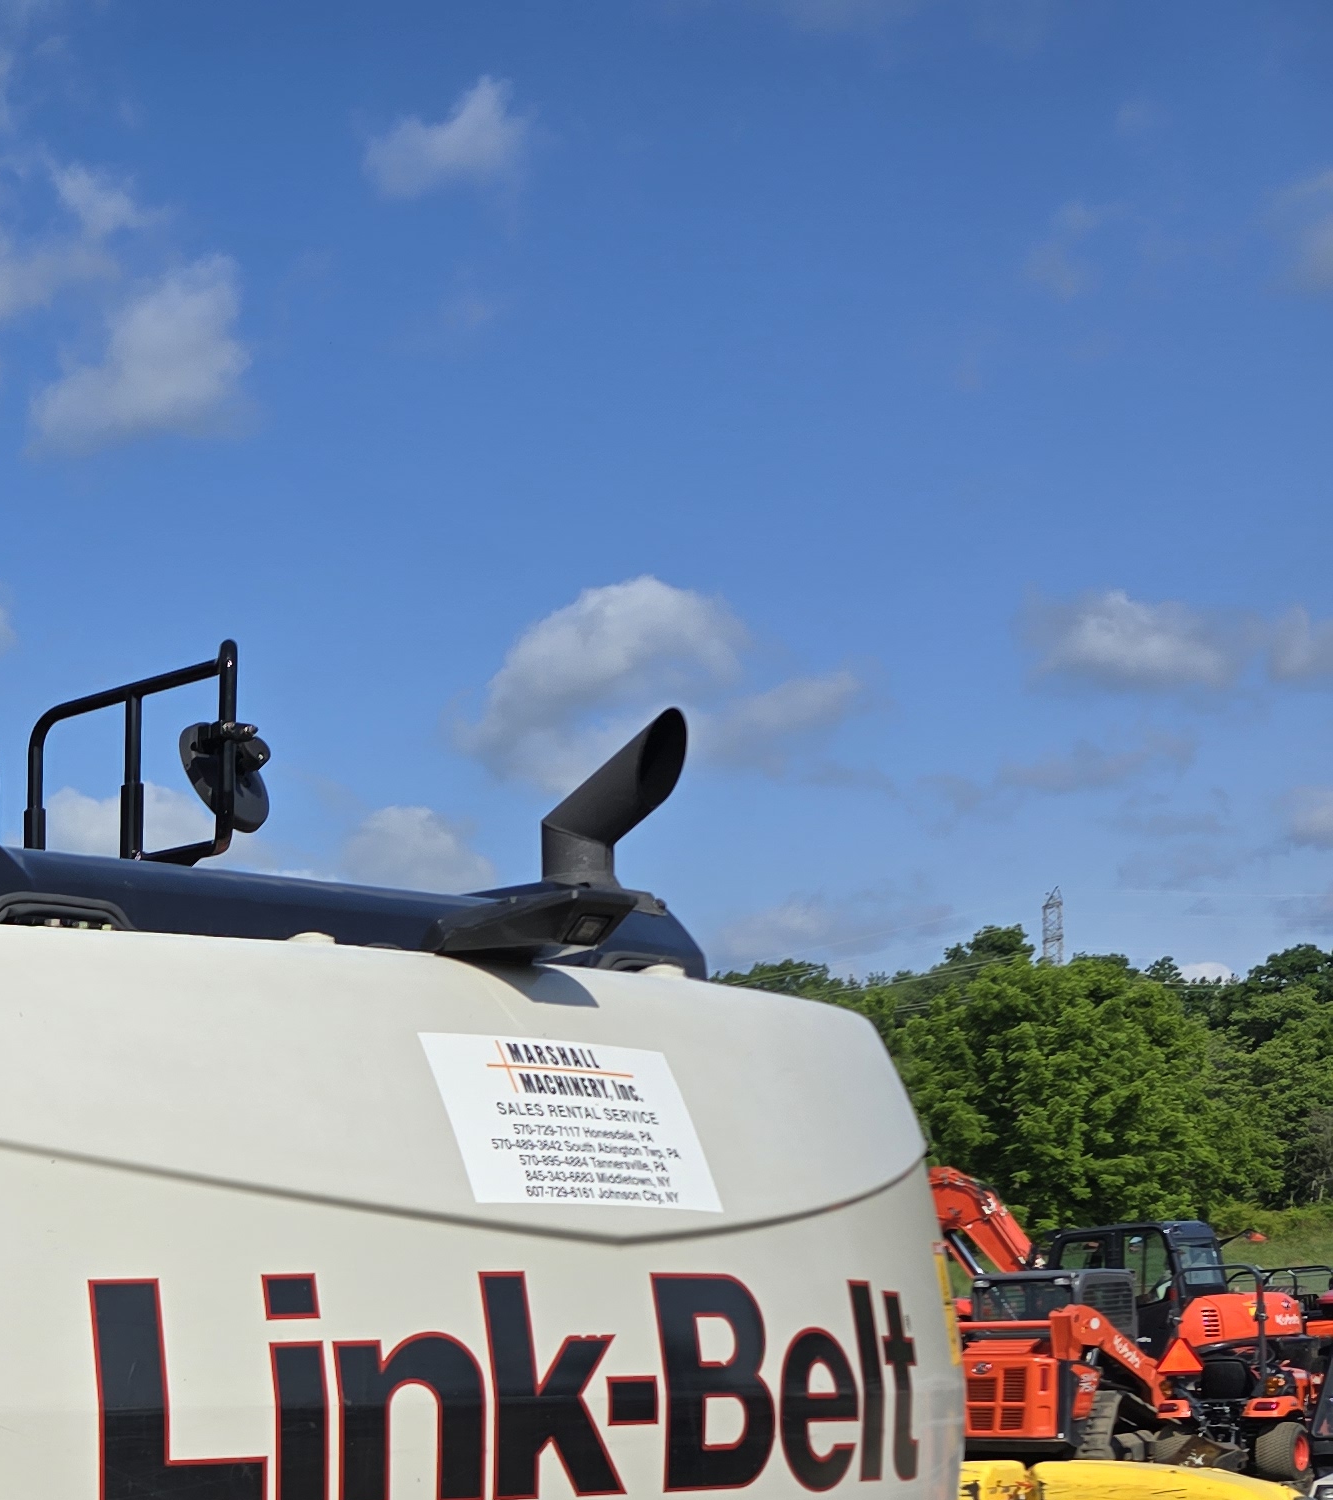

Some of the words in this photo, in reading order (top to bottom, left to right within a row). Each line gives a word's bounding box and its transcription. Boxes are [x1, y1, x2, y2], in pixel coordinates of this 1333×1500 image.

[505, 1042, 601, 1069] MARSHALL
[518, 1072, 613, 1101] MACHINERY,
[611, 1079, 644, 1102] Inc.
[496, 1101, 544, 1117] SALES
[547, 1104, 602, 1120] RENTAL
[602, 1107, 659, 1125] SERVICE
[513, 1123, 580, 1137] 570-729-7117
[639, 1130, 655, 1143] PA
[564, 1140, 596, 1153] South
[597, 1142, 643, 1158] Abington
[666, 1147, 682, 1160] PA
[653, 1160, 669, 1173] PA
[656, 1176, 671, 1188] NY
[597, 1187, 642, 1201] Johnson
[642, 1189, 665, 1204] City,
[664, 1191, 679, 1203] NY
